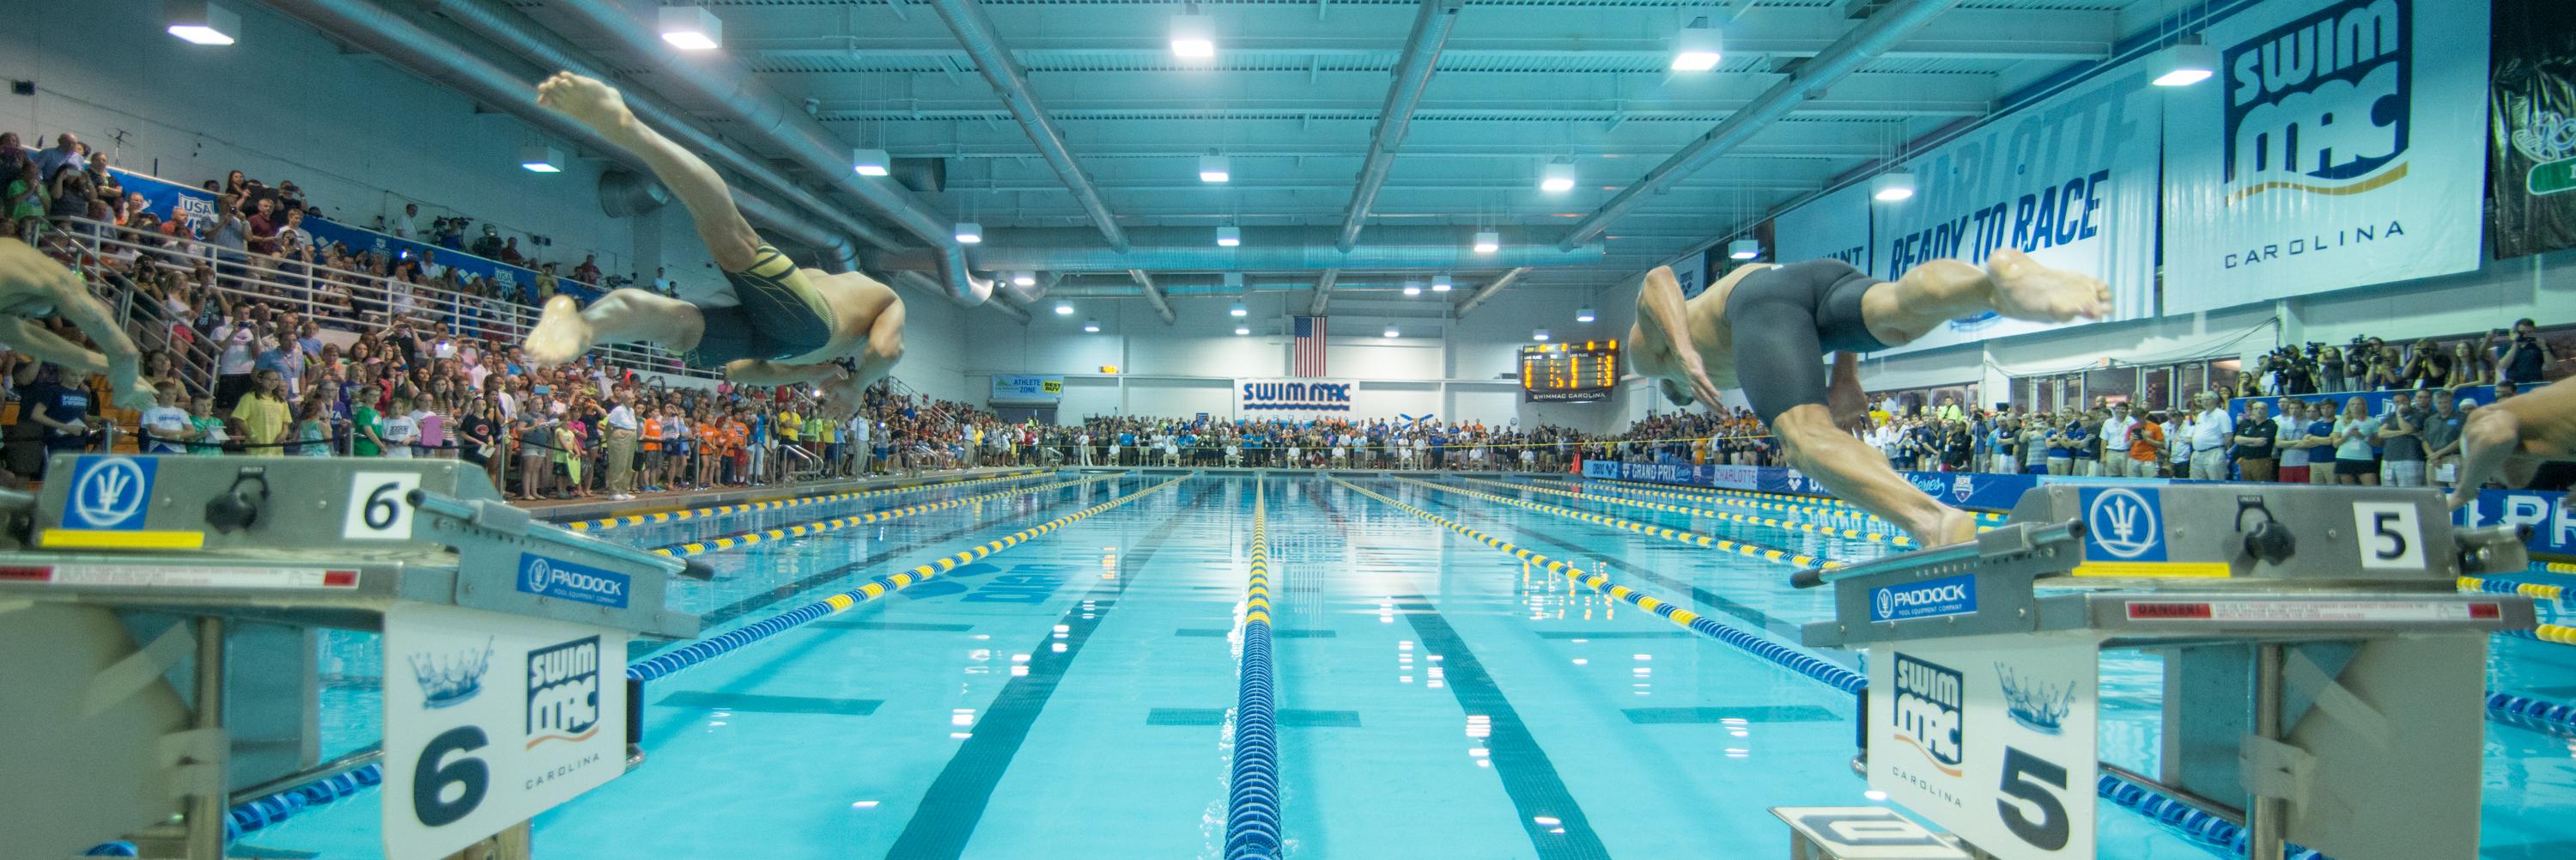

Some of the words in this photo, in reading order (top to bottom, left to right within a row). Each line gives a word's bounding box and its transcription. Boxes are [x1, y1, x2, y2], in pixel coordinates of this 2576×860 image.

[2233, 0, 2398, 107] SWIM
[2232, 61, 2398, 181] MAC
[1894, 69, 2148, 225] HARLOTTE
[184, 199, 212, 215] USA
[1889, 214, 1969, 282] READY
[1973, 202, 2008, 265] TO
[2011, 168, 2110, 253] RACE
[2225, 220, 2404, 269] CAROLINA
[1243, 382, 1306, 401] SWIM
[1309, 382, 1351, 401] MAC
[1631, 464, 1657, 479] GRAND
[1657, 464, 1676, 480] PRIX
[363, 481, 401, 531] 6
[2373, 511, 2407, 560] 5
[550, 569, 623, 596] PADDOCK
[1893, 583, 1967, 607] PADDOCK
[1911, 606, 1937, 616] EQUIPMENT
[1938, 603, 1962, 613] COMPANY
[532, 643, 597, 690] SWIM
[1897, 659, 1959, 709] SWIM
[532, 675, 597, 733] MAC
[1897, 692, 1959, 762] MAC
[413, 724, 490, 827] 6
[526, 753, 600, 790] CAROLINA
[1893, 766, 1962, 808] CAROLINA
[1996, 745, 2070, 852] 5
